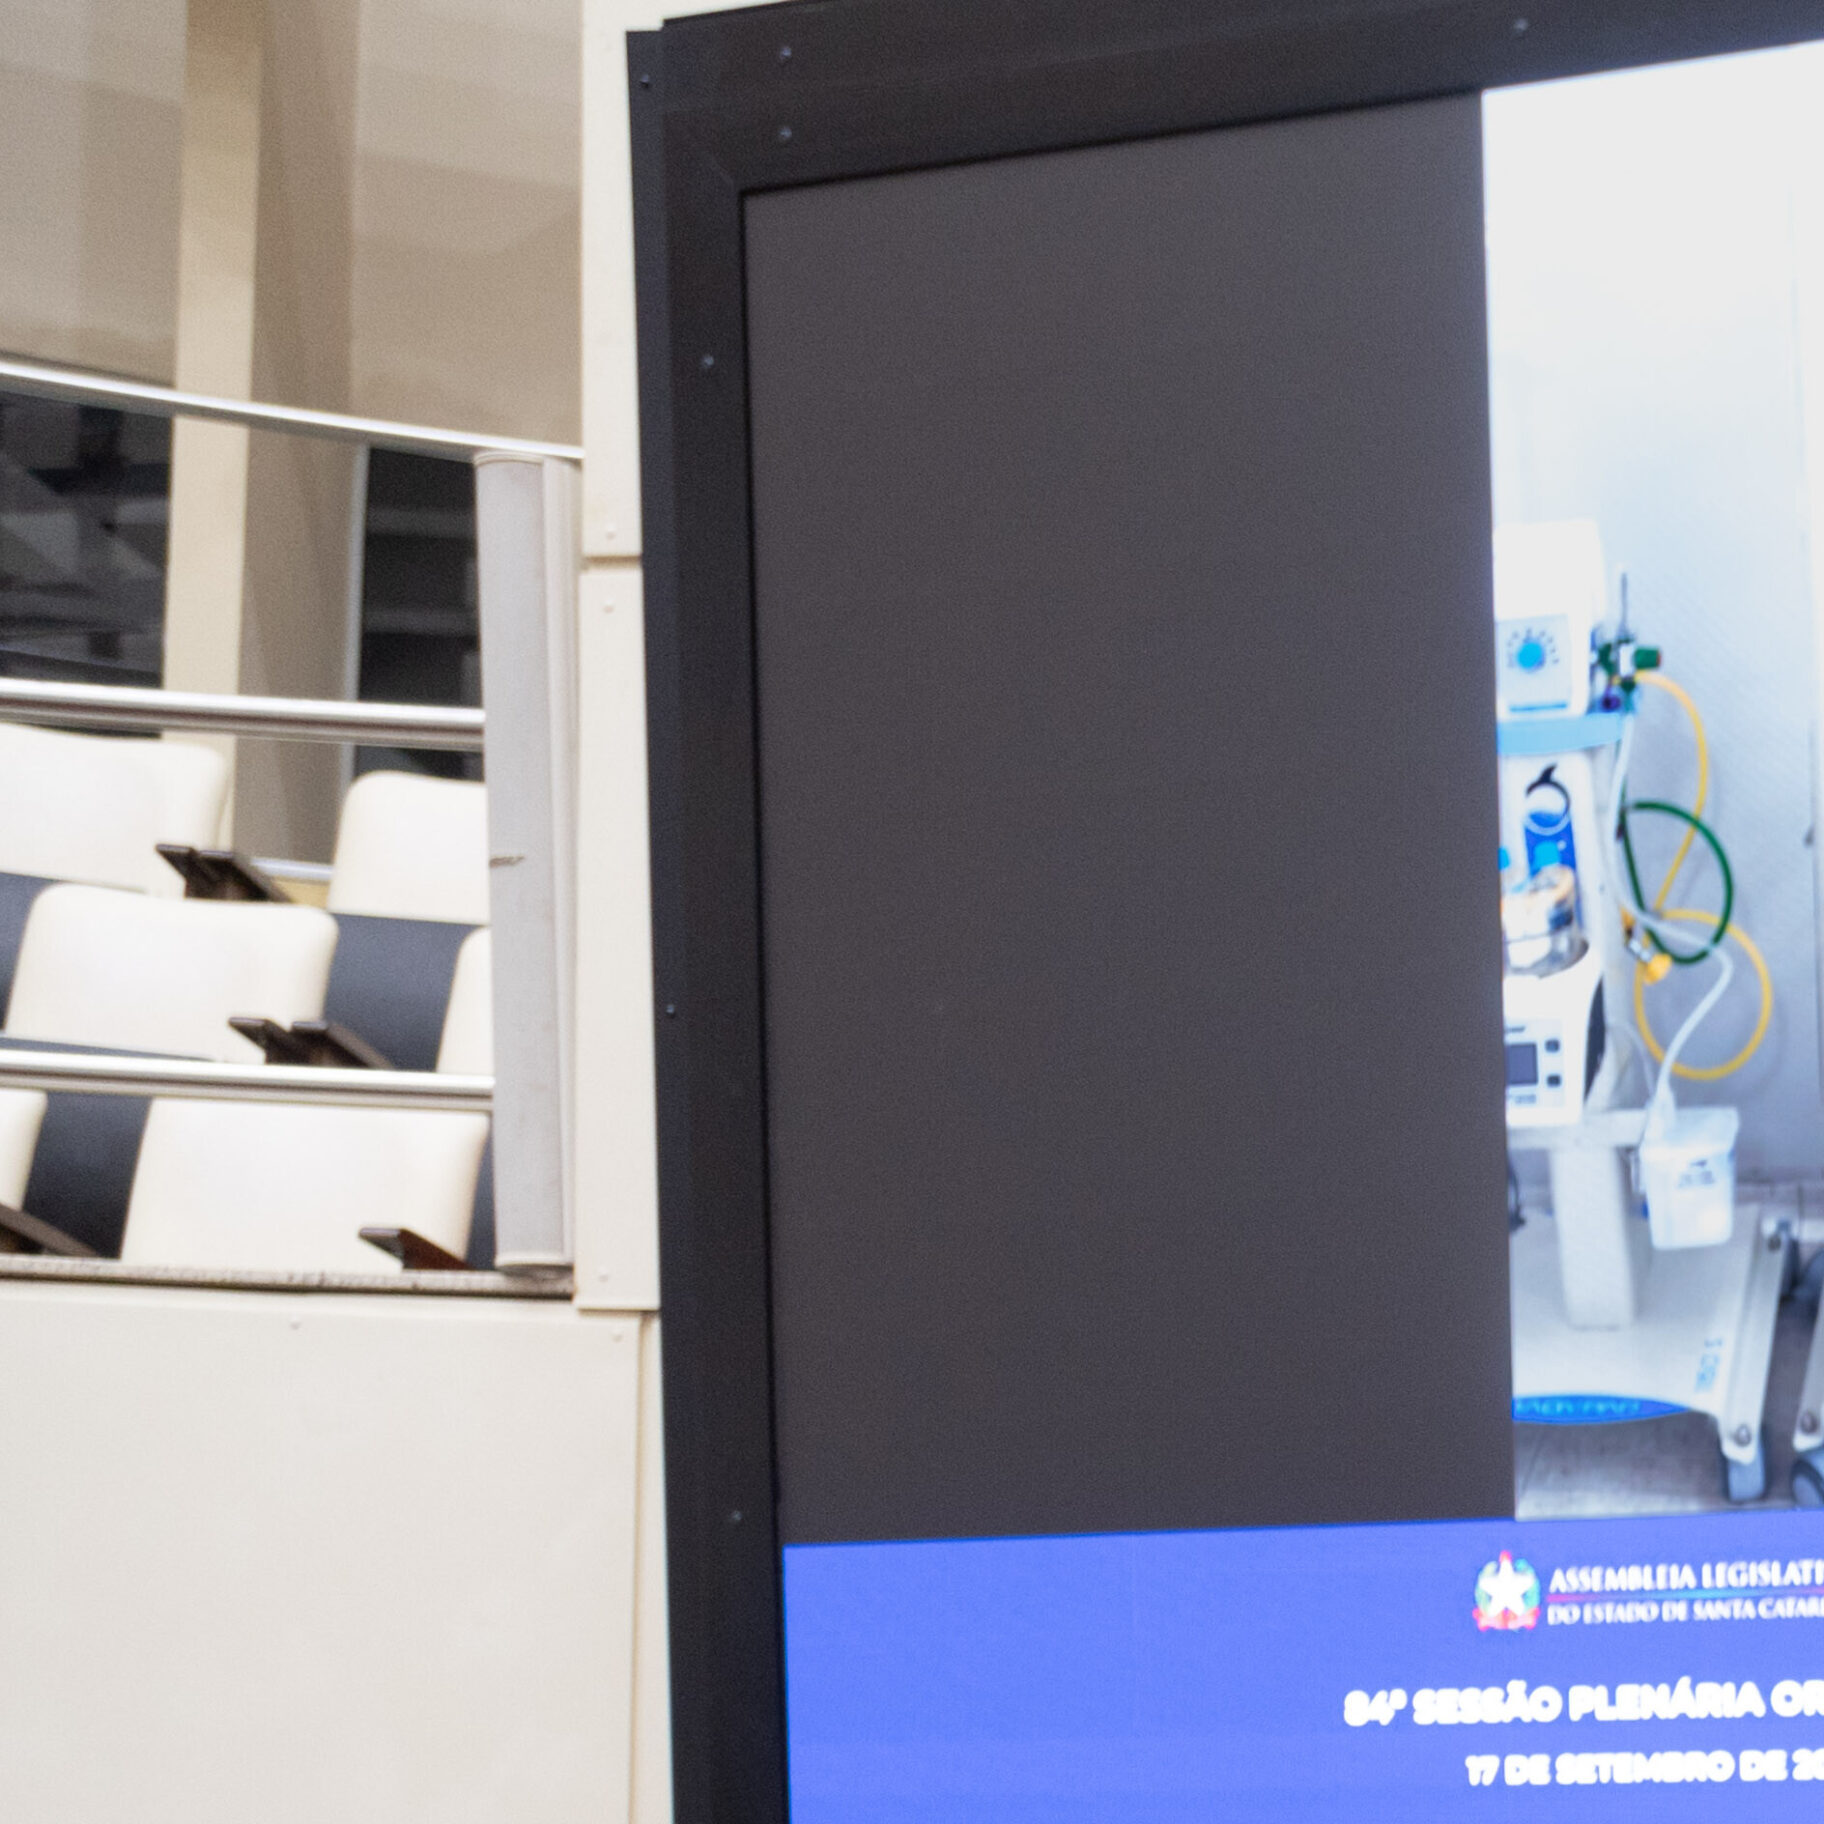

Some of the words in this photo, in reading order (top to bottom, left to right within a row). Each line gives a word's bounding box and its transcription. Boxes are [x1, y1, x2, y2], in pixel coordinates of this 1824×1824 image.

[1549, 1565, 1697, 1593] ASSEMBLEIA
[1547, 1603, 1581, 1625] DO
[1583, 1602, 1659, 1624] ESTADO
[1662, 1600, 1688, 1621] DE
[1693, 1598, 1756, 1621] SANTA
[1412, 1680, 1563, 1725] SESSÃO
[1569, 1676, 1766, 1721] PLENÁRIA
[1465, 1755, 1500, 1786] 17
[1504, 1754, 1551, 1786] DE
[1555, 1750, 1736, 1785] SETEMBRO
[1739, 1749, 1788, 1781] DE
